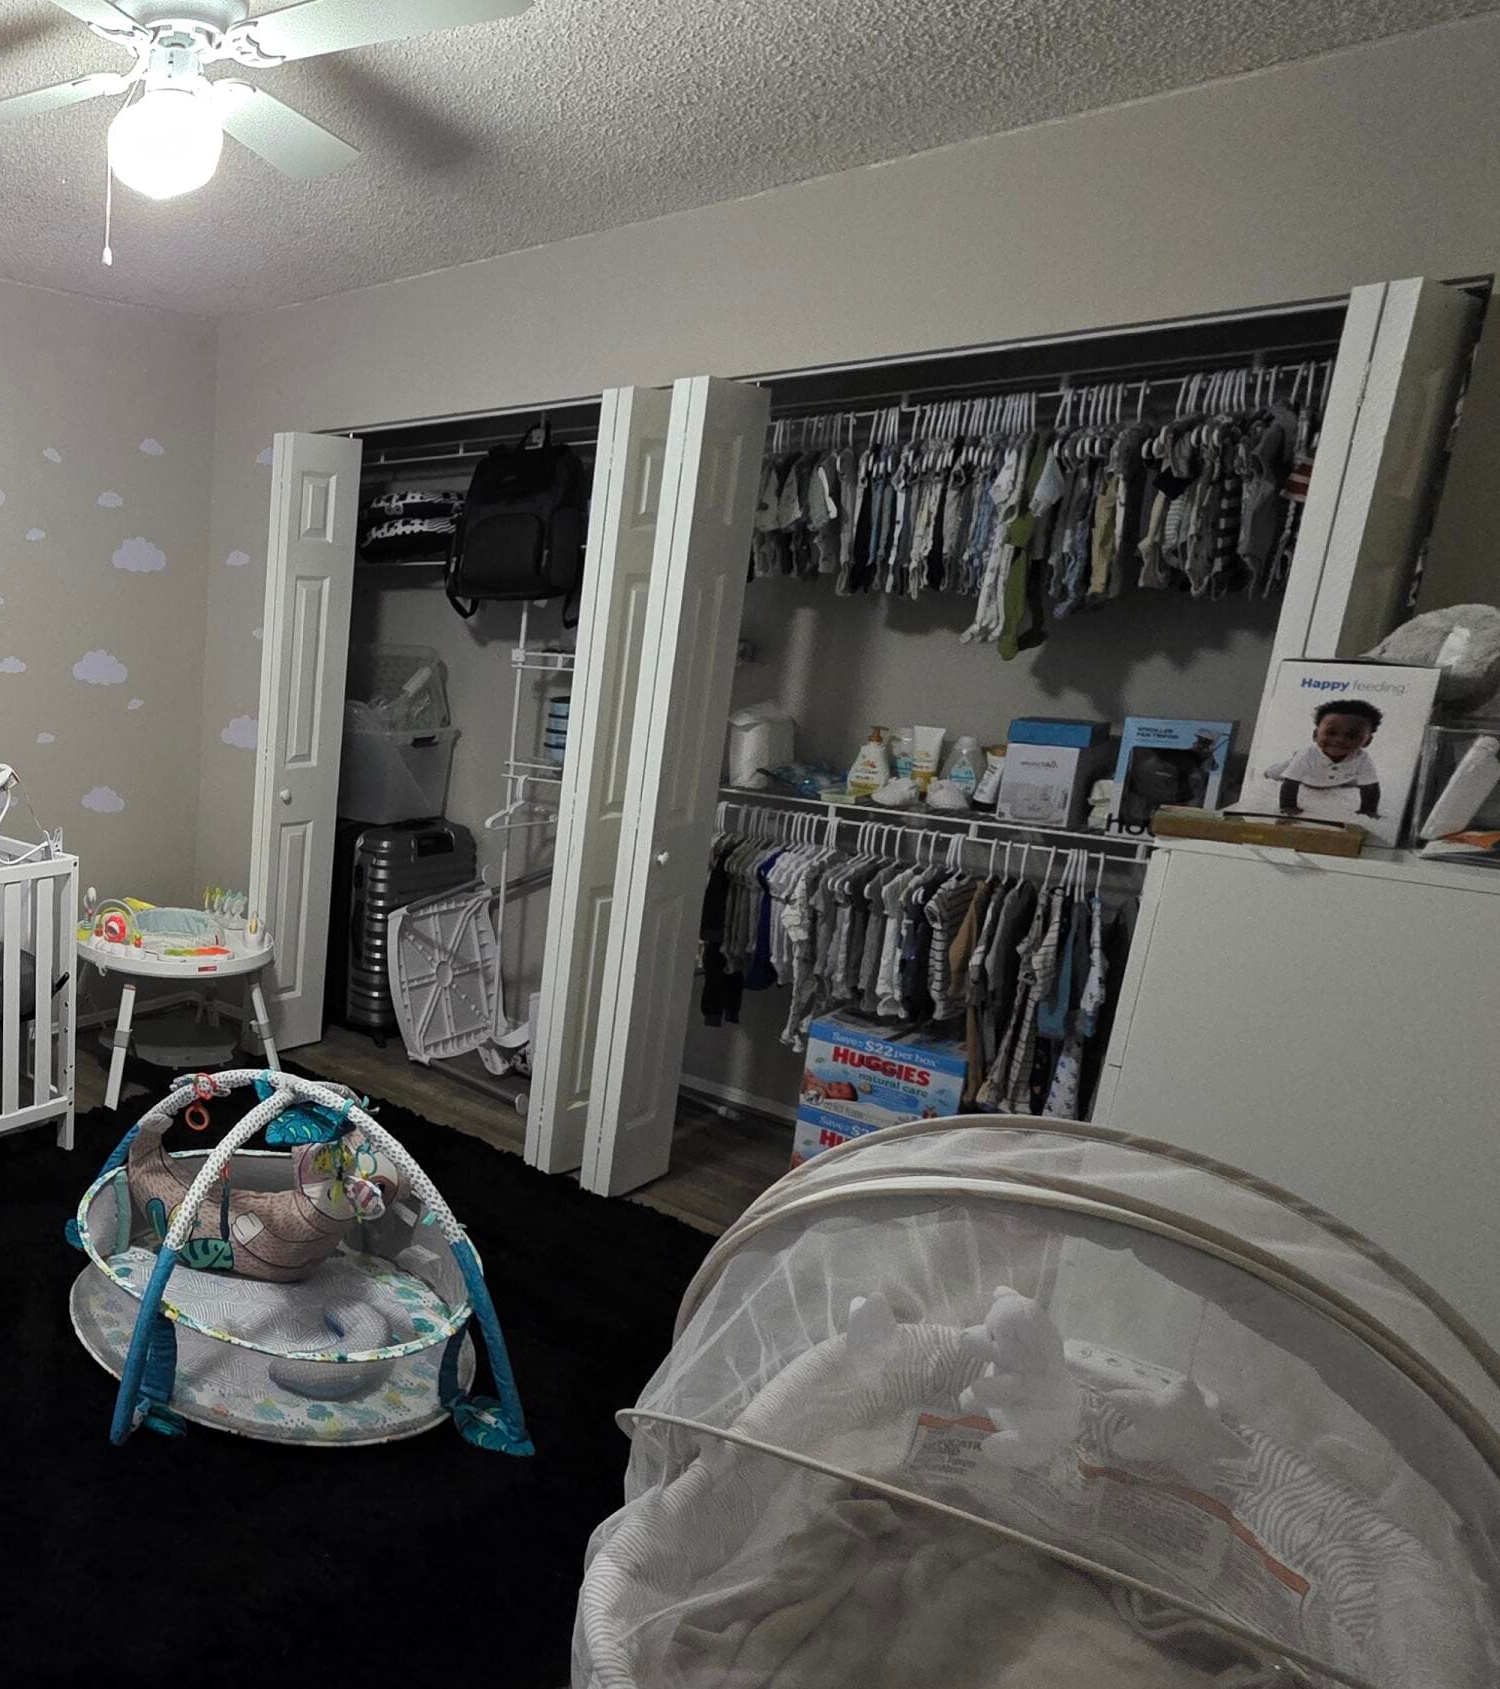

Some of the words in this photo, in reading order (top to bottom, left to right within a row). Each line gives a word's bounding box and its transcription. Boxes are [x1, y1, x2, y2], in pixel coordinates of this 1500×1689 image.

[1301, 677, 1350, 692] Happy
[831, 1045, 931, 1087] HUGGIES
[865, 1039, 894, 1058] $22
[894, 1048, 913, 1062] per
[914, 1053, 937, 1067] box
[858, 1072, 901, 1090] natural
[903, 1085, 929, 1098] care
